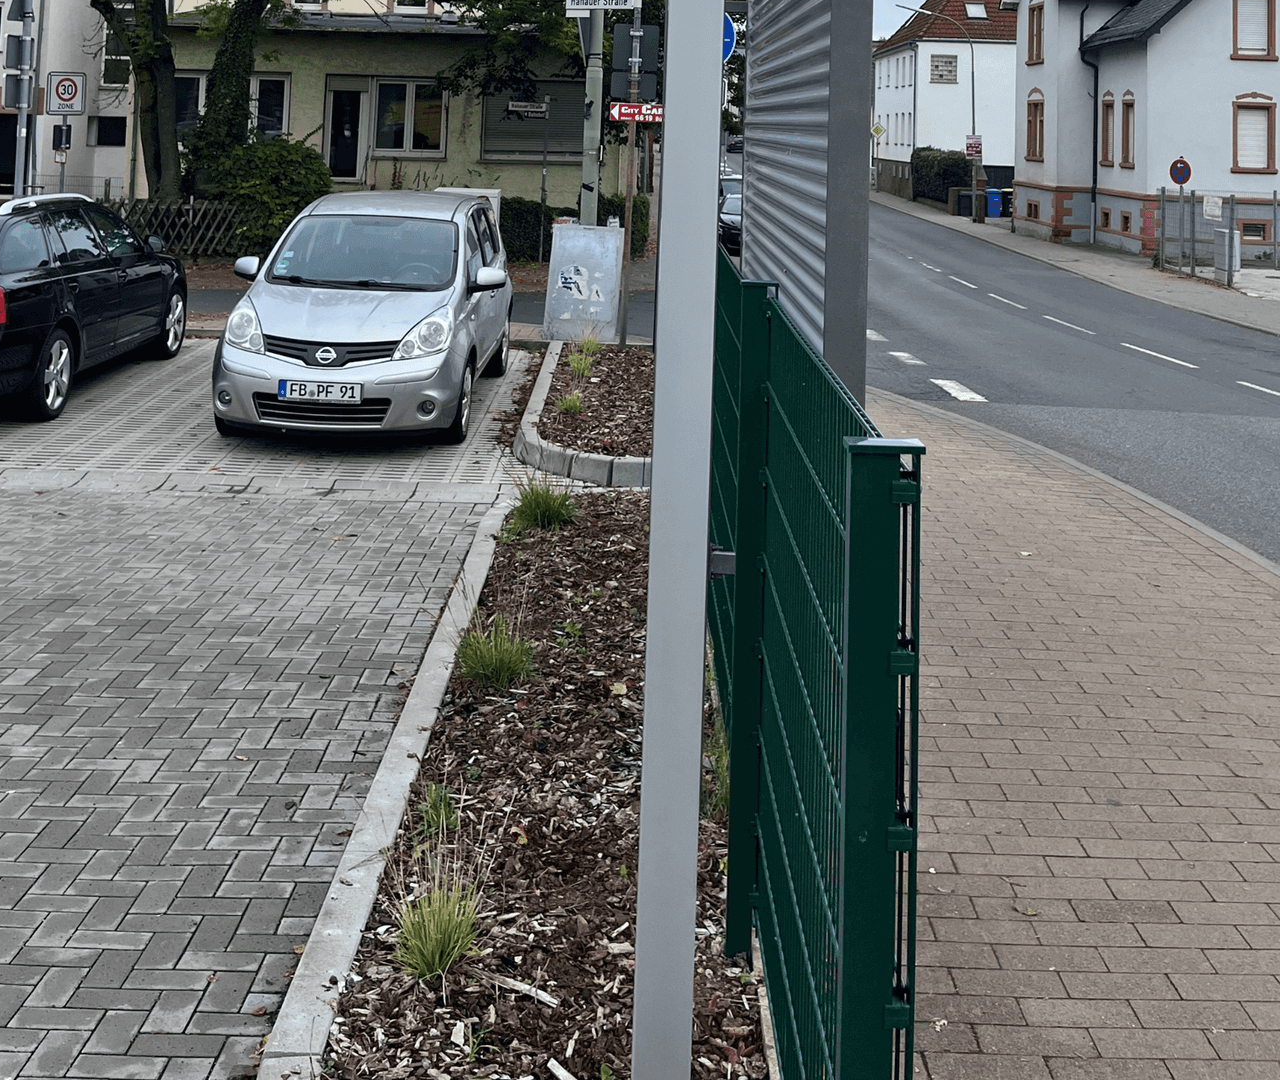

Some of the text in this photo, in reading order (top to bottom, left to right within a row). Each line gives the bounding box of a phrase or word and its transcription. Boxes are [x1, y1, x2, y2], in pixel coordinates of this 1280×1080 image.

[60, 84, 74, 96] 30
[290, 383, 356, 399] FB PF 91
